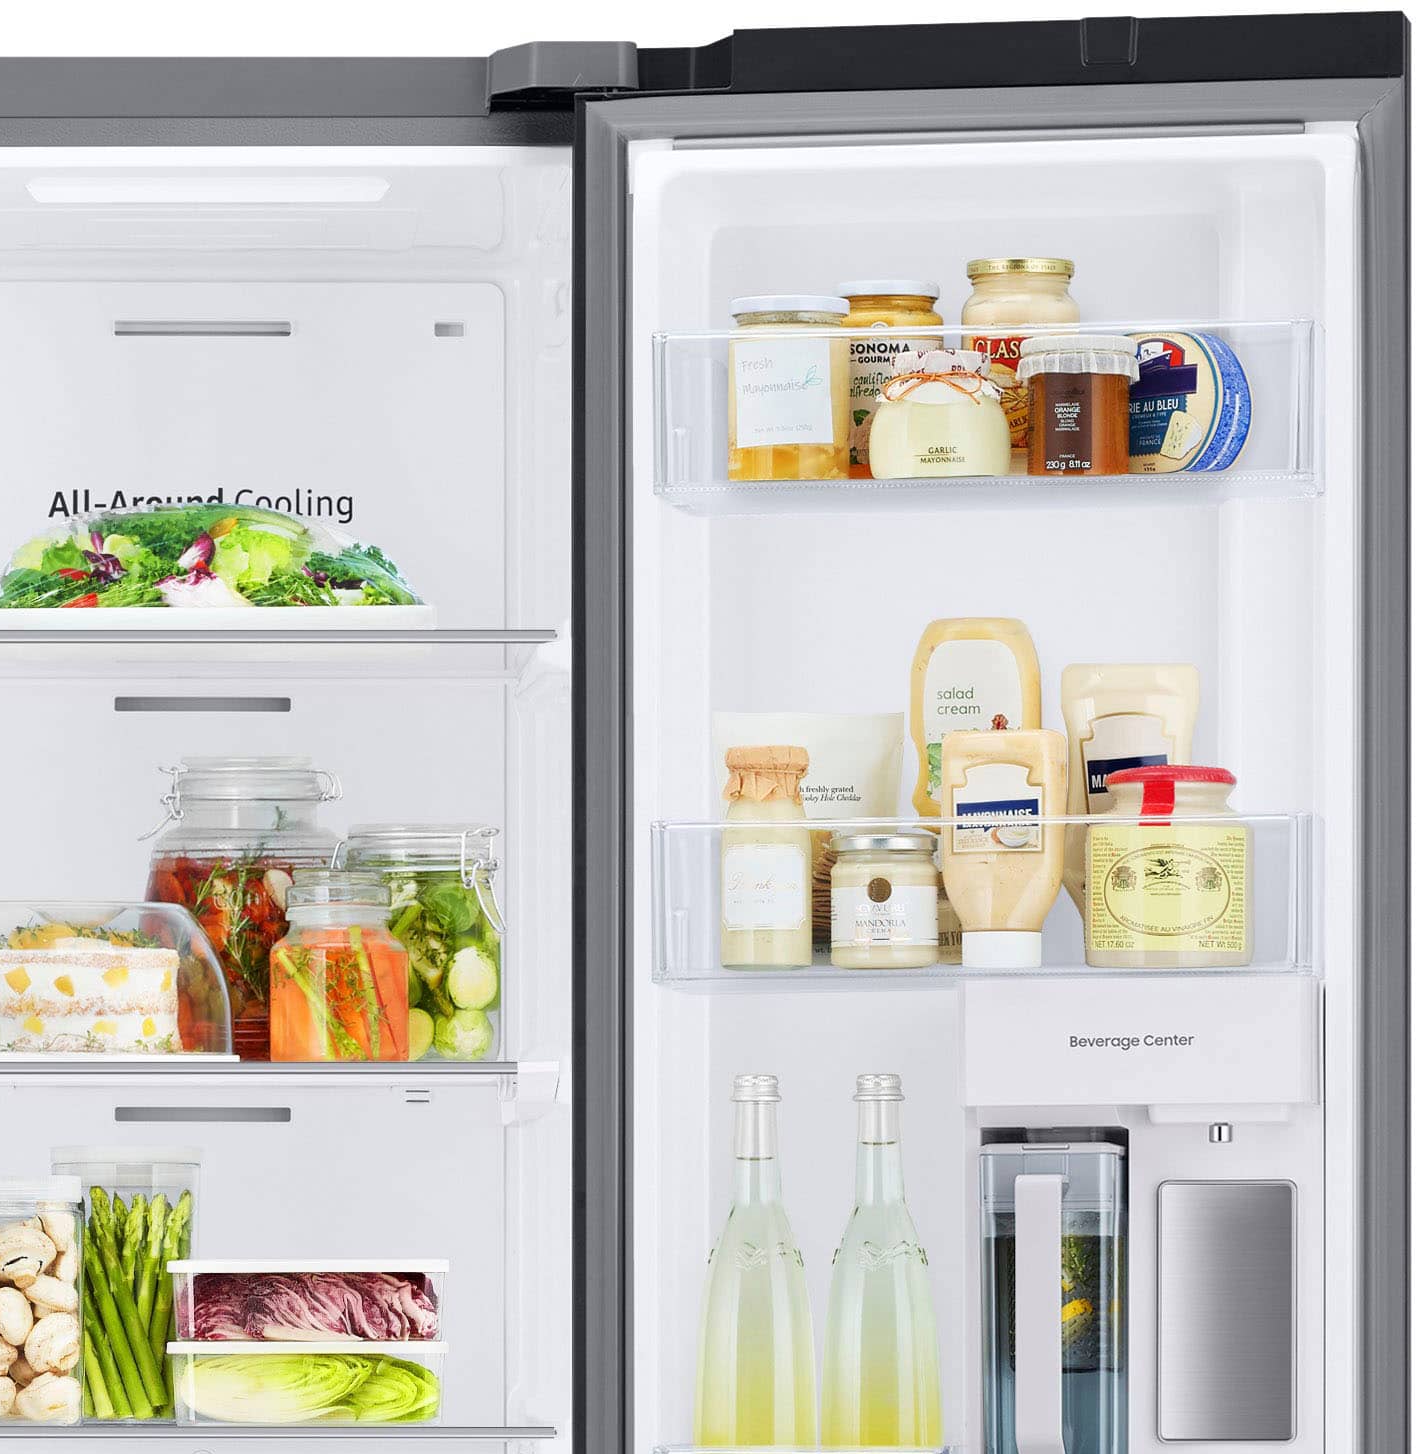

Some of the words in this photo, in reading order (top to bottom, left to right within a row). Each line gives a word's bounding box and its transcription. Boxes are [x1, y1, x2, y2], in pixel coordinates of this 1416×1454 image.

[850, 343, 911, 354] SONOMA
[742, 357, 773, 373] Fresh
[744, 379, 809, 396] Mayonnaise
[1143, 400, 1155, 413] AU
[1157, 398, 1179, 411] BLEU
[928, 446, 958, 454] GARLIC
[1046, 461, 1059, 469] 230
[234, 488, 354, 524] Cooling
[937, 687, 975, 700] salad
[937, 705, 982, 716] cream
[806, 785, 829, 794] freshly
[830, 785, 854, 794] grated
[836, 793, 861, 801] Cheddar
[855, 919, 906, 928] MANDORLA
[1095, 940, 1106, 948] NET
[1199, 940, 1215, 948] NET
[1069, 1035, 1140, 1051] Beverage
[1143, 1034, 1195, 1047] Center
